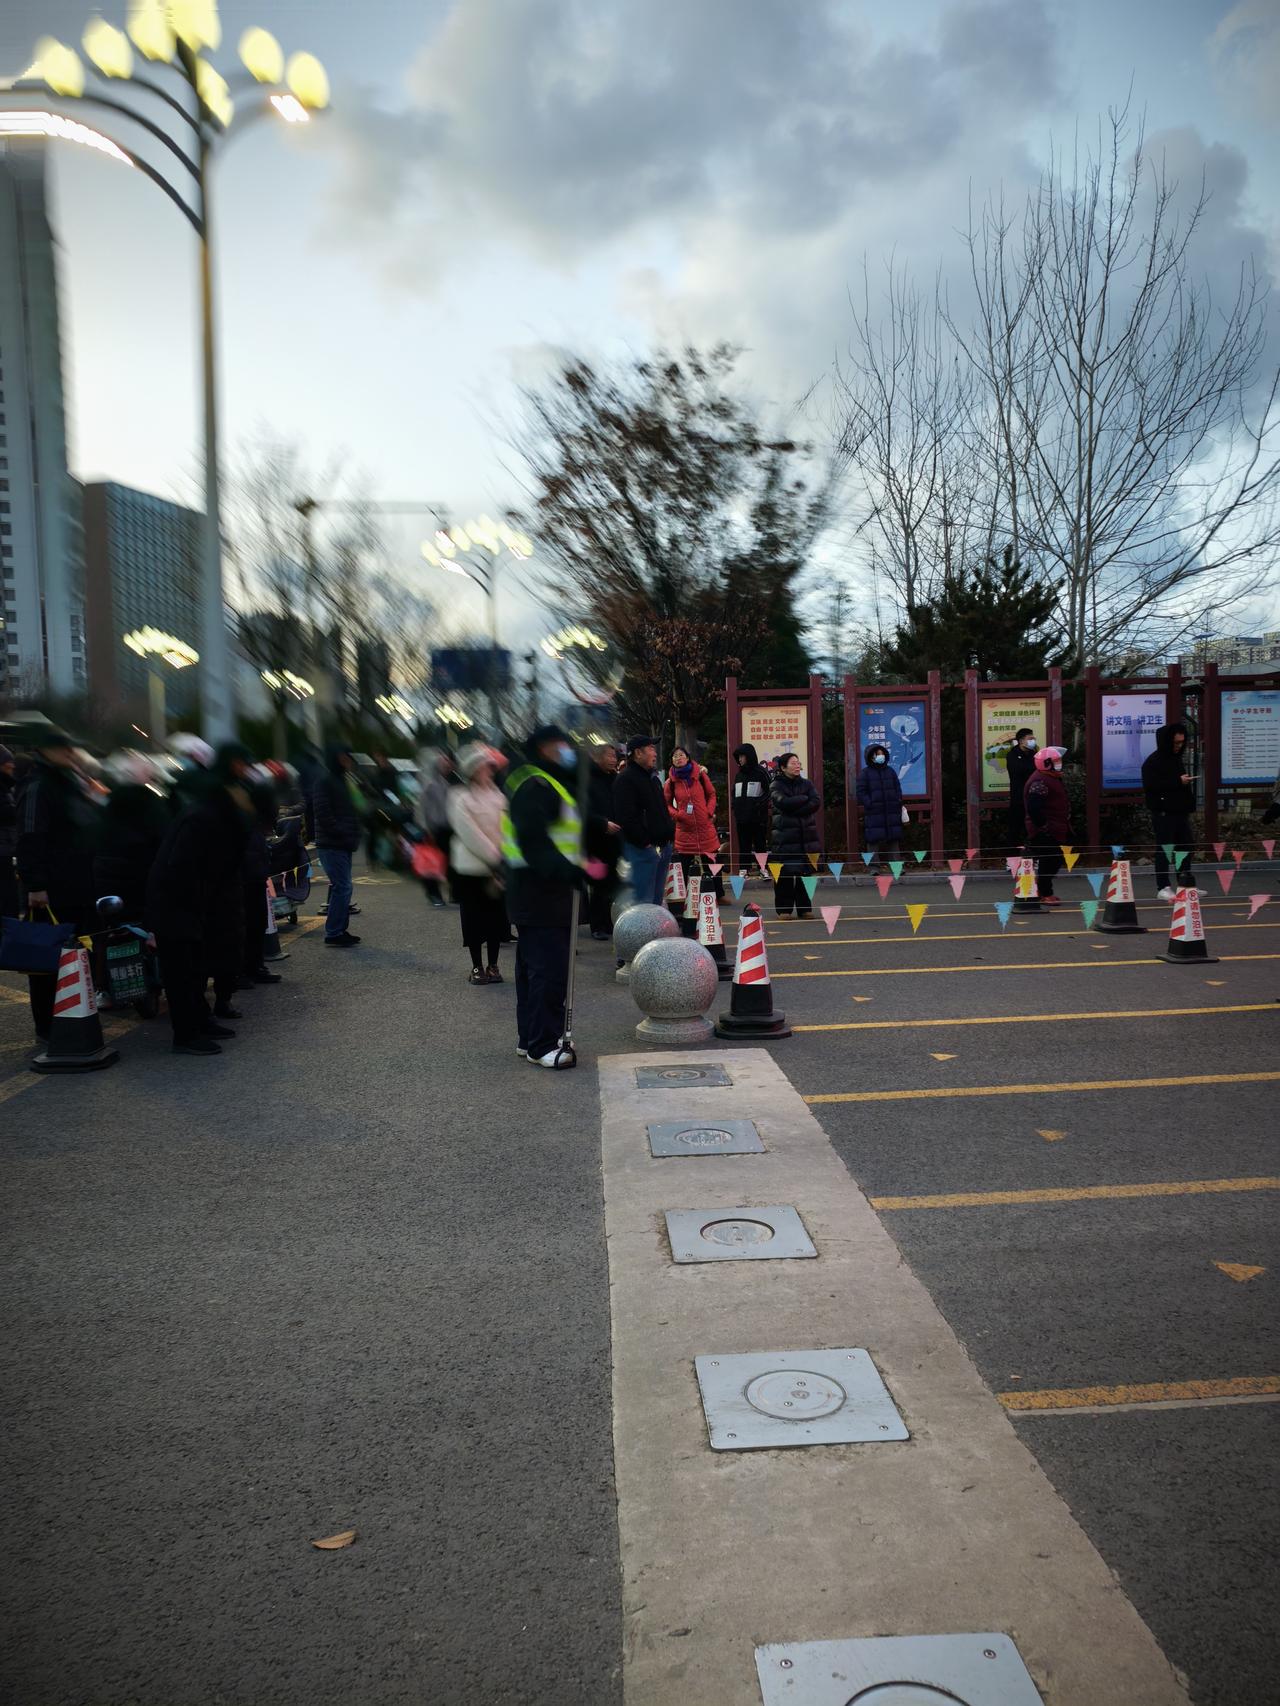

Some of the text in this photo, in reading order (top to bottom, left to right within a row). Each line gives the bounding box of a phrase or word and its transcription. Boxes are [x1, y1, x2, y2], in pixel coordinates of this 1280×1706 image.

[868, 725, 886, 733] 少年强
[1106, 715, 1163, 726] 讲文明 讲卫生
[705, 907, 716, 942] 请勿泊车
[1191, 902, 1202, 937] 请勿泊车
